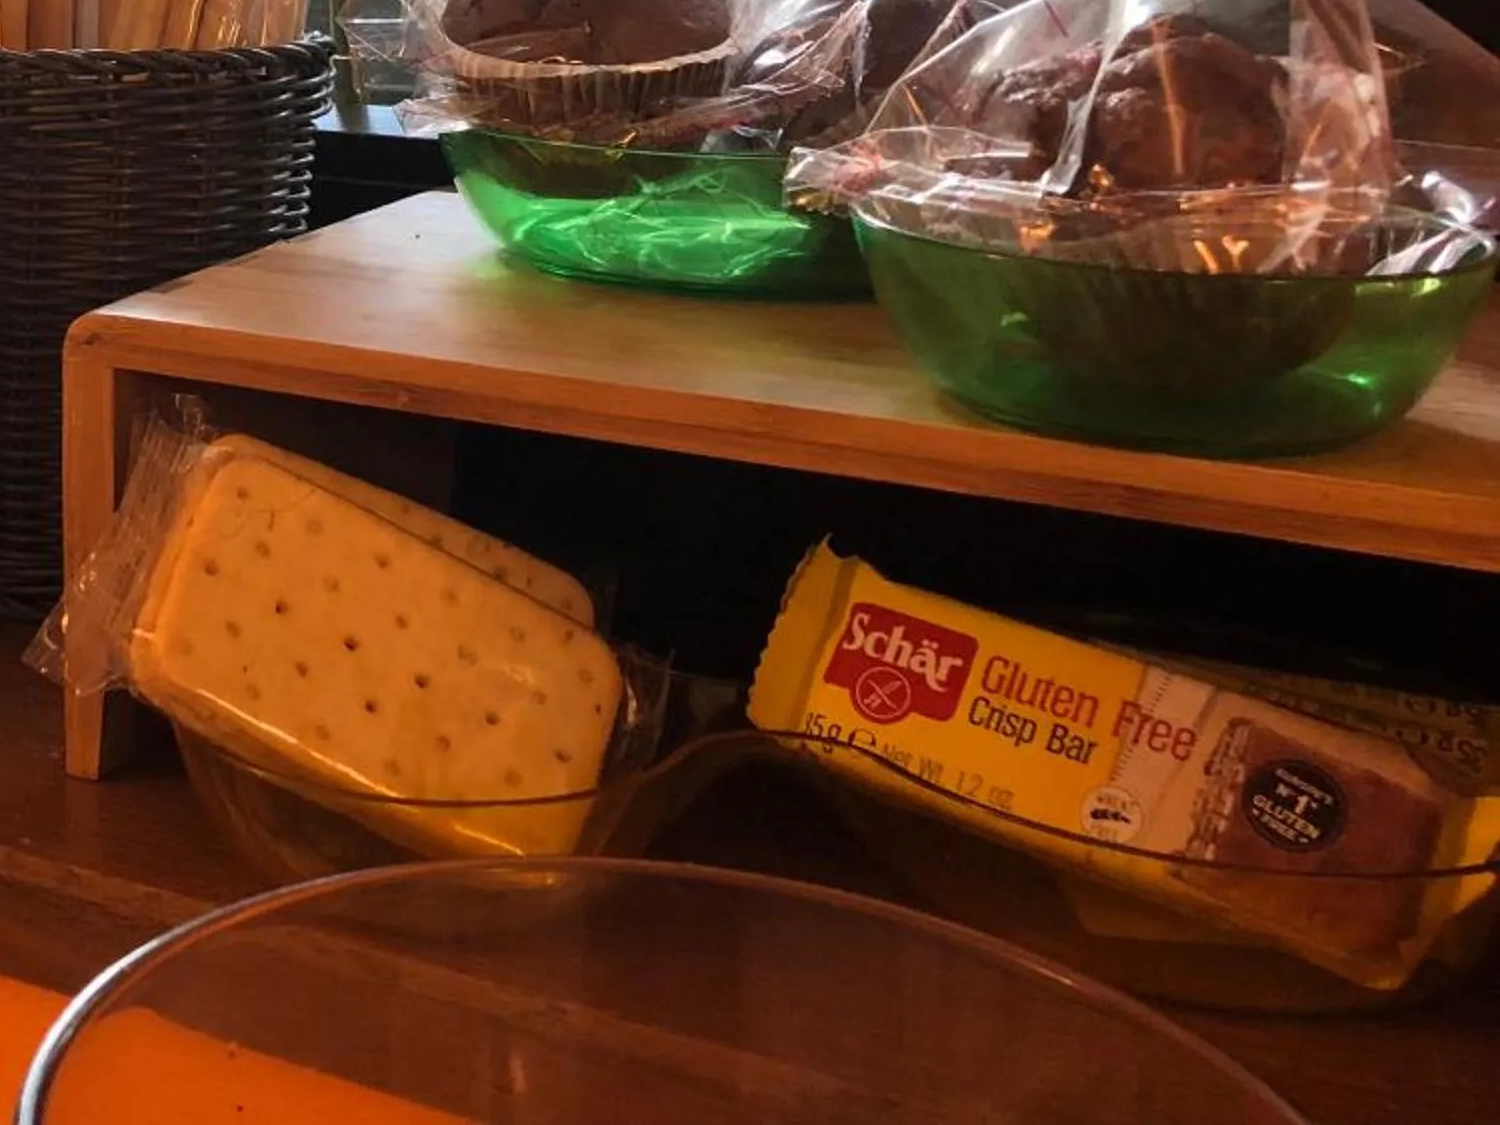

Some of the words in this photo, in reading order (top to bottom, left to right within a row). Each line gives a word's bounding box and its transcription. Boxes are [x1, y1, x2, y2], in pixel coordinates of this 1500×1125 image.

[842, 612, 965, 693] Schär
[969, 695, 1038, 748] Crisp
[1045, 723, 1099, 765] Bar
[981, 655, 1099, 729] Gluten
[1112, 699, 1197, 762] Free
